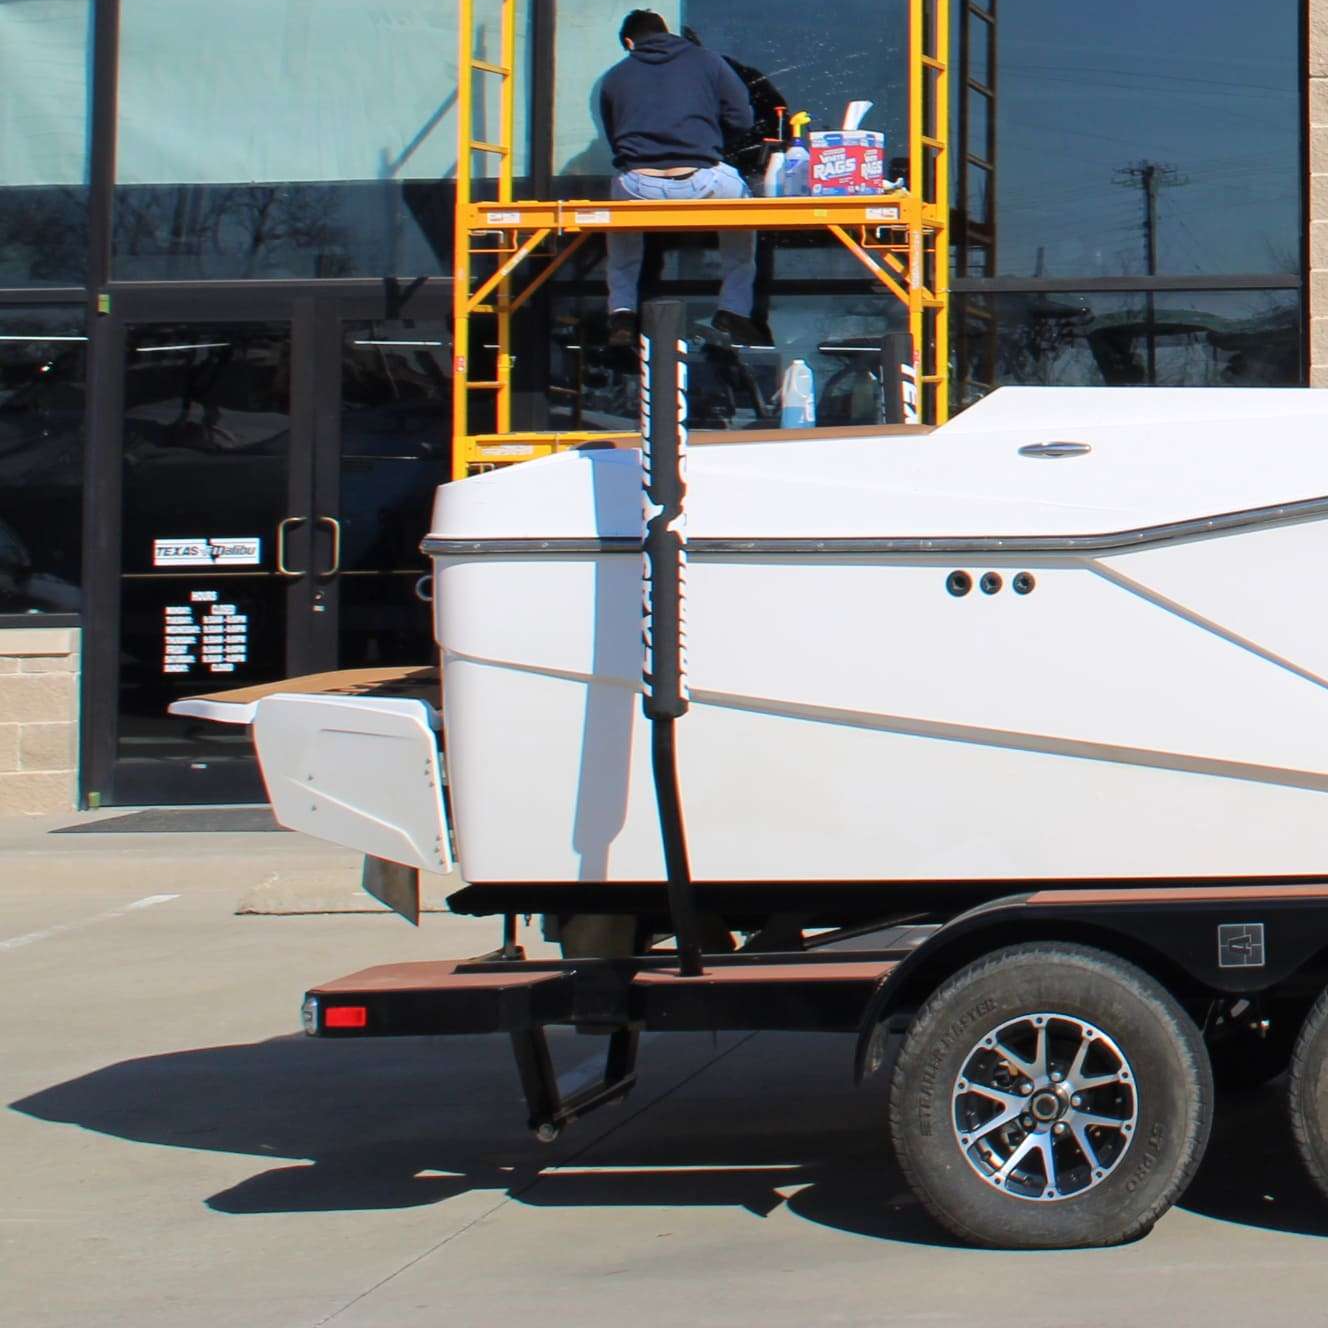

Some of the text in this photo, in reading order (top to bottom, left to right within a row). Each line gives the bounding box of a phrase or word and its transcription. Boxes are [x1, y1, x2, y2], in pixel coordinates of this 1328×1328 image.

[813, 158, 857, 180] RAGS
[156, 544, 257, 557] TEXAS Malibu
